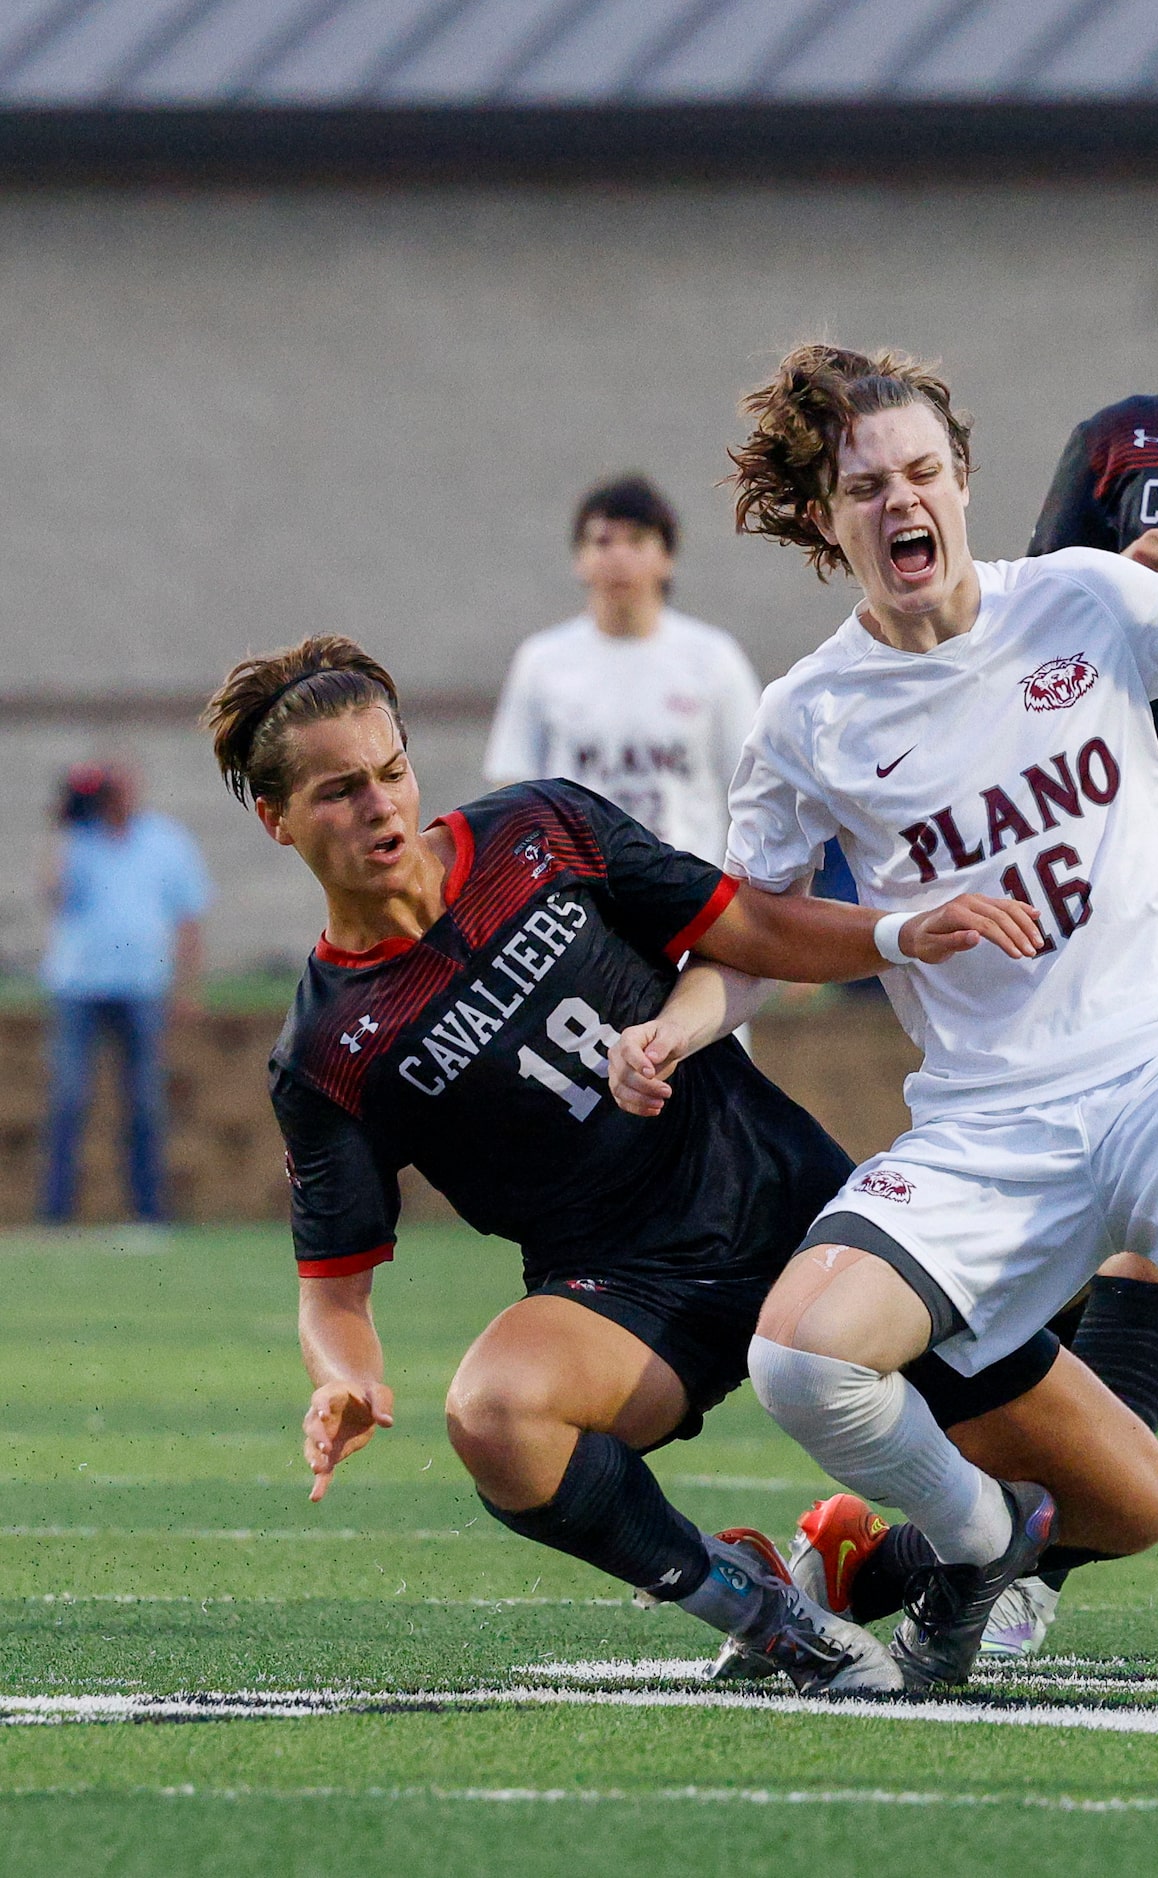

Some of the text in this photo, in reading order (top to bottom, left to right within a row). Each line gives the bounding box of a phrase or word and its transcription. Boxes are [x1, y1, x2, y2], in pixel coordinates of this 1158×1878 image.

[898, 736, 1121, 884] PLANO
[1000, 842, 1093, 959] 16
[399, 892, 589, 1097] CAVALIERS
[517, 997, 624, 1123] 18
